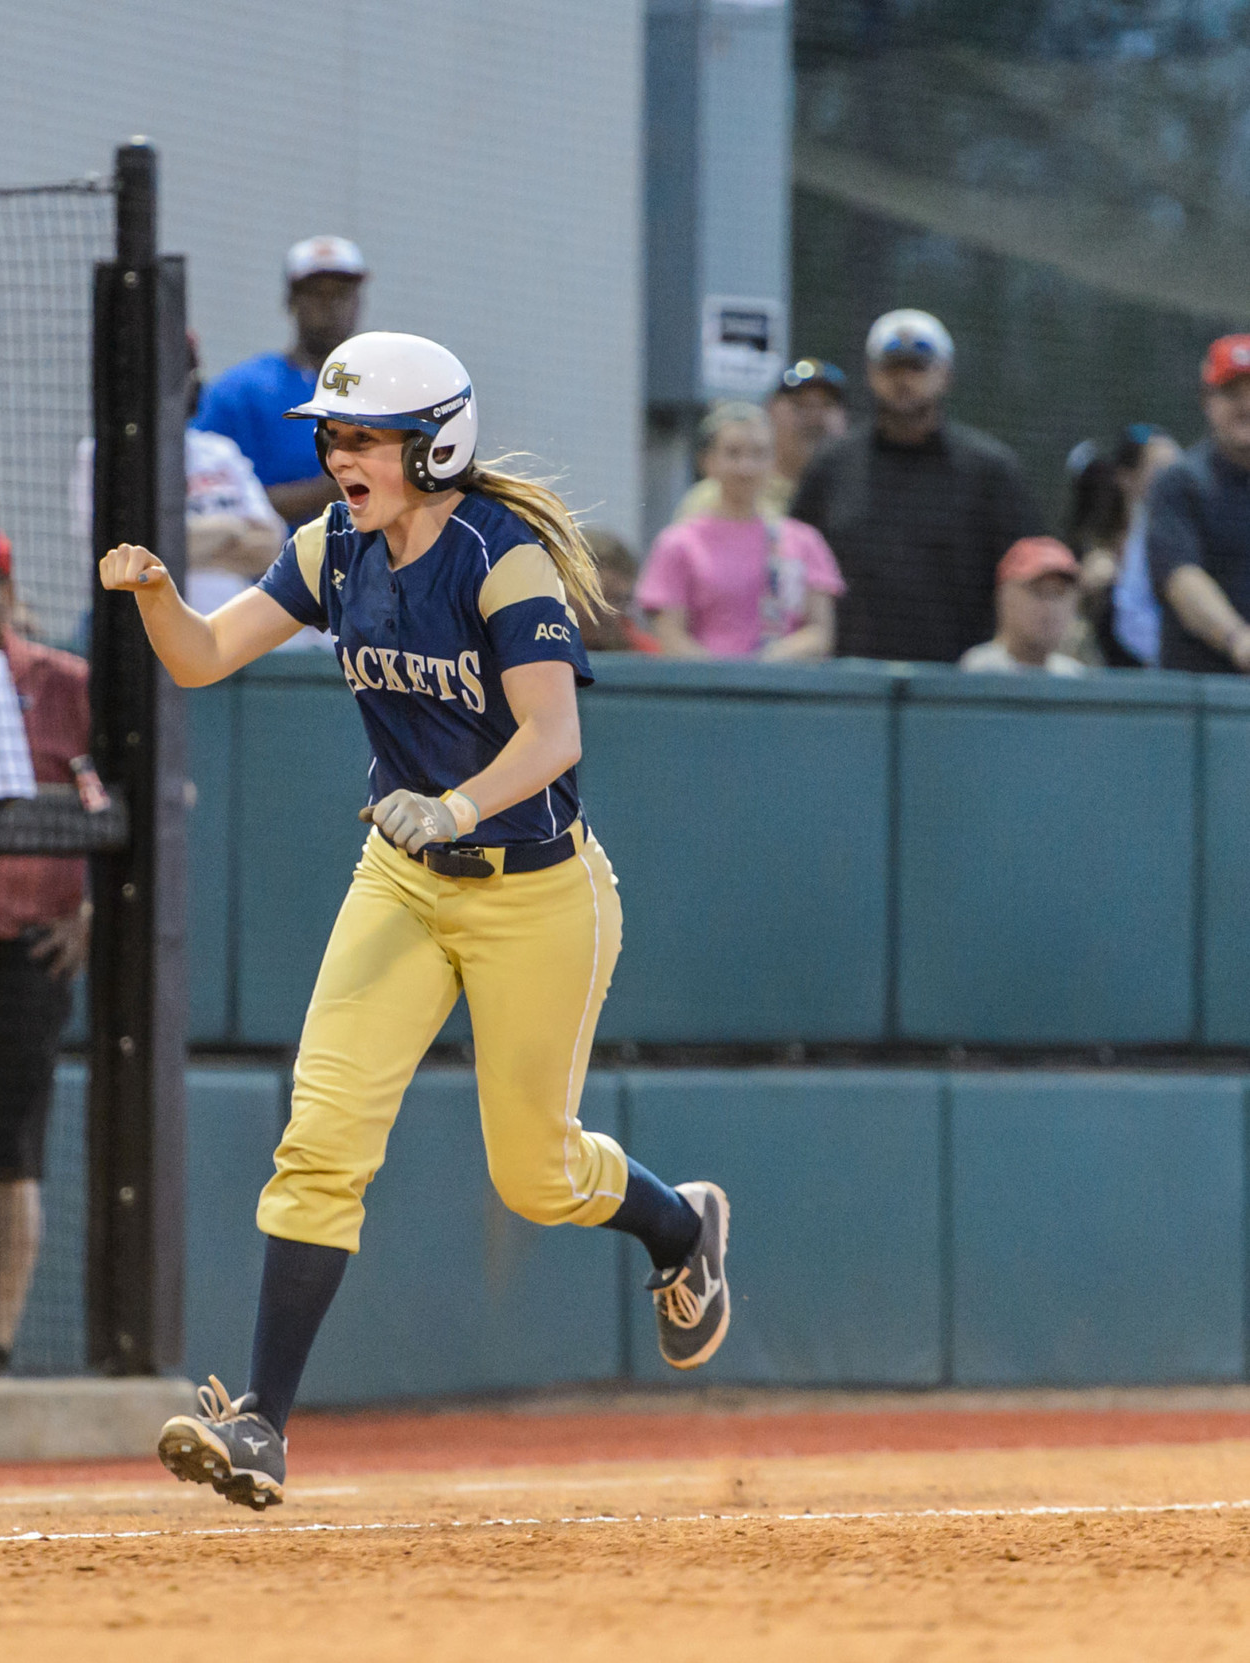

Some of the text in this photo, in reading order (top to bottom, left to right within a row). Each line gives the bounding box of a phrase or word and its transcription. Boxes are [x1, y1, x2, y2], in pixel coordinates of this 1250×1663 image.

[534, 622, 571, 644] ACC
[332, 635, 486, 714] ACKETS
[420, 815, 439, 837] 25
